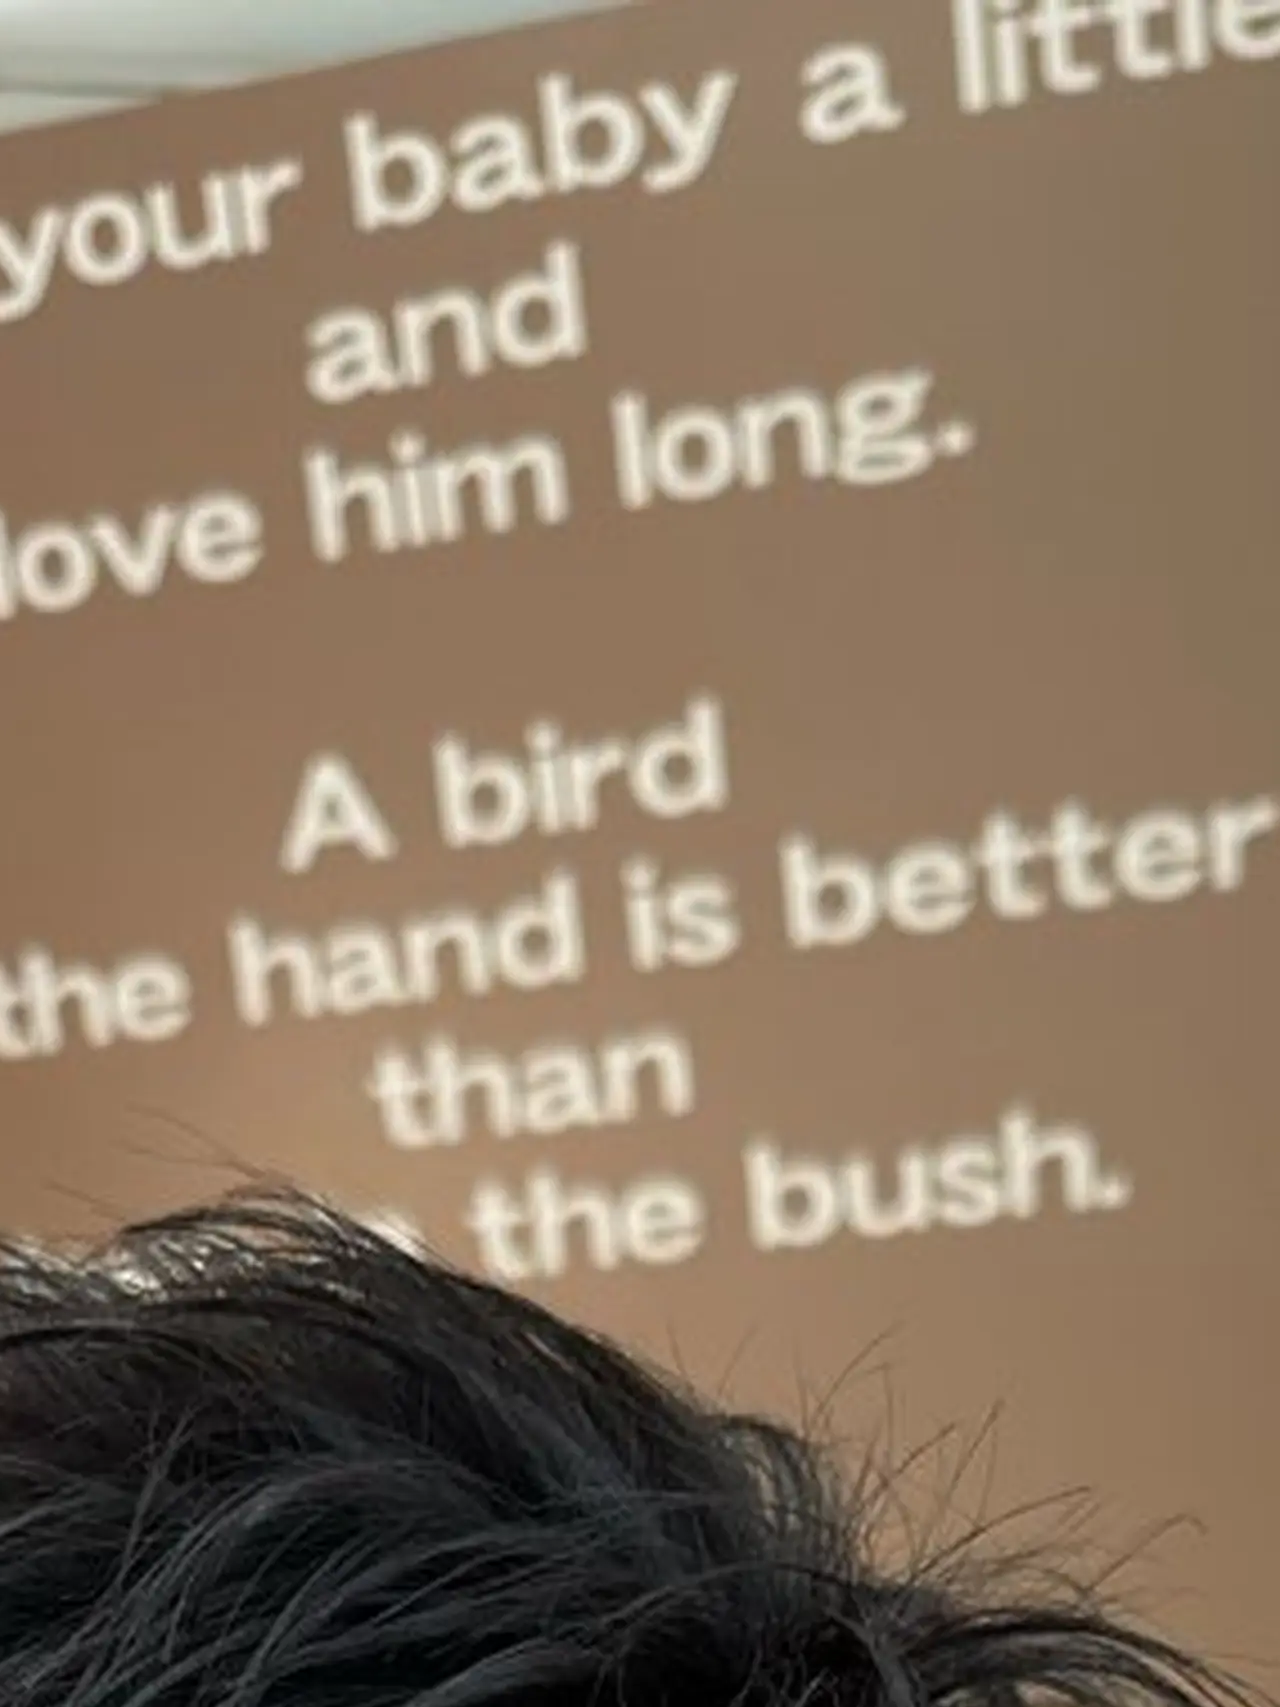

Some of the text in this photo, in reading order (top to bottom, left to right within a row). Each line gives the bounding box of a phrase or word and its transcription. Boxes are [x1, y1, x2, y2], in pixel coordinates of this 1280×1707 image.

[345, 74, 733, 230] baby
[800, 45, 904, 144] a
[306, 241, 586, 402] and
[304, 432, 568, 562] him
[612, 370, 972, 507] long.
[282, 700, 726, 872] A bird
[230, 872, 583, 1023] hand
[626, 862, 738, 969] is
[370, 1030, 692, 1147] than
[470, 1167, 701, 1282] the
[747, 1106, 1128, 1254] bush.
